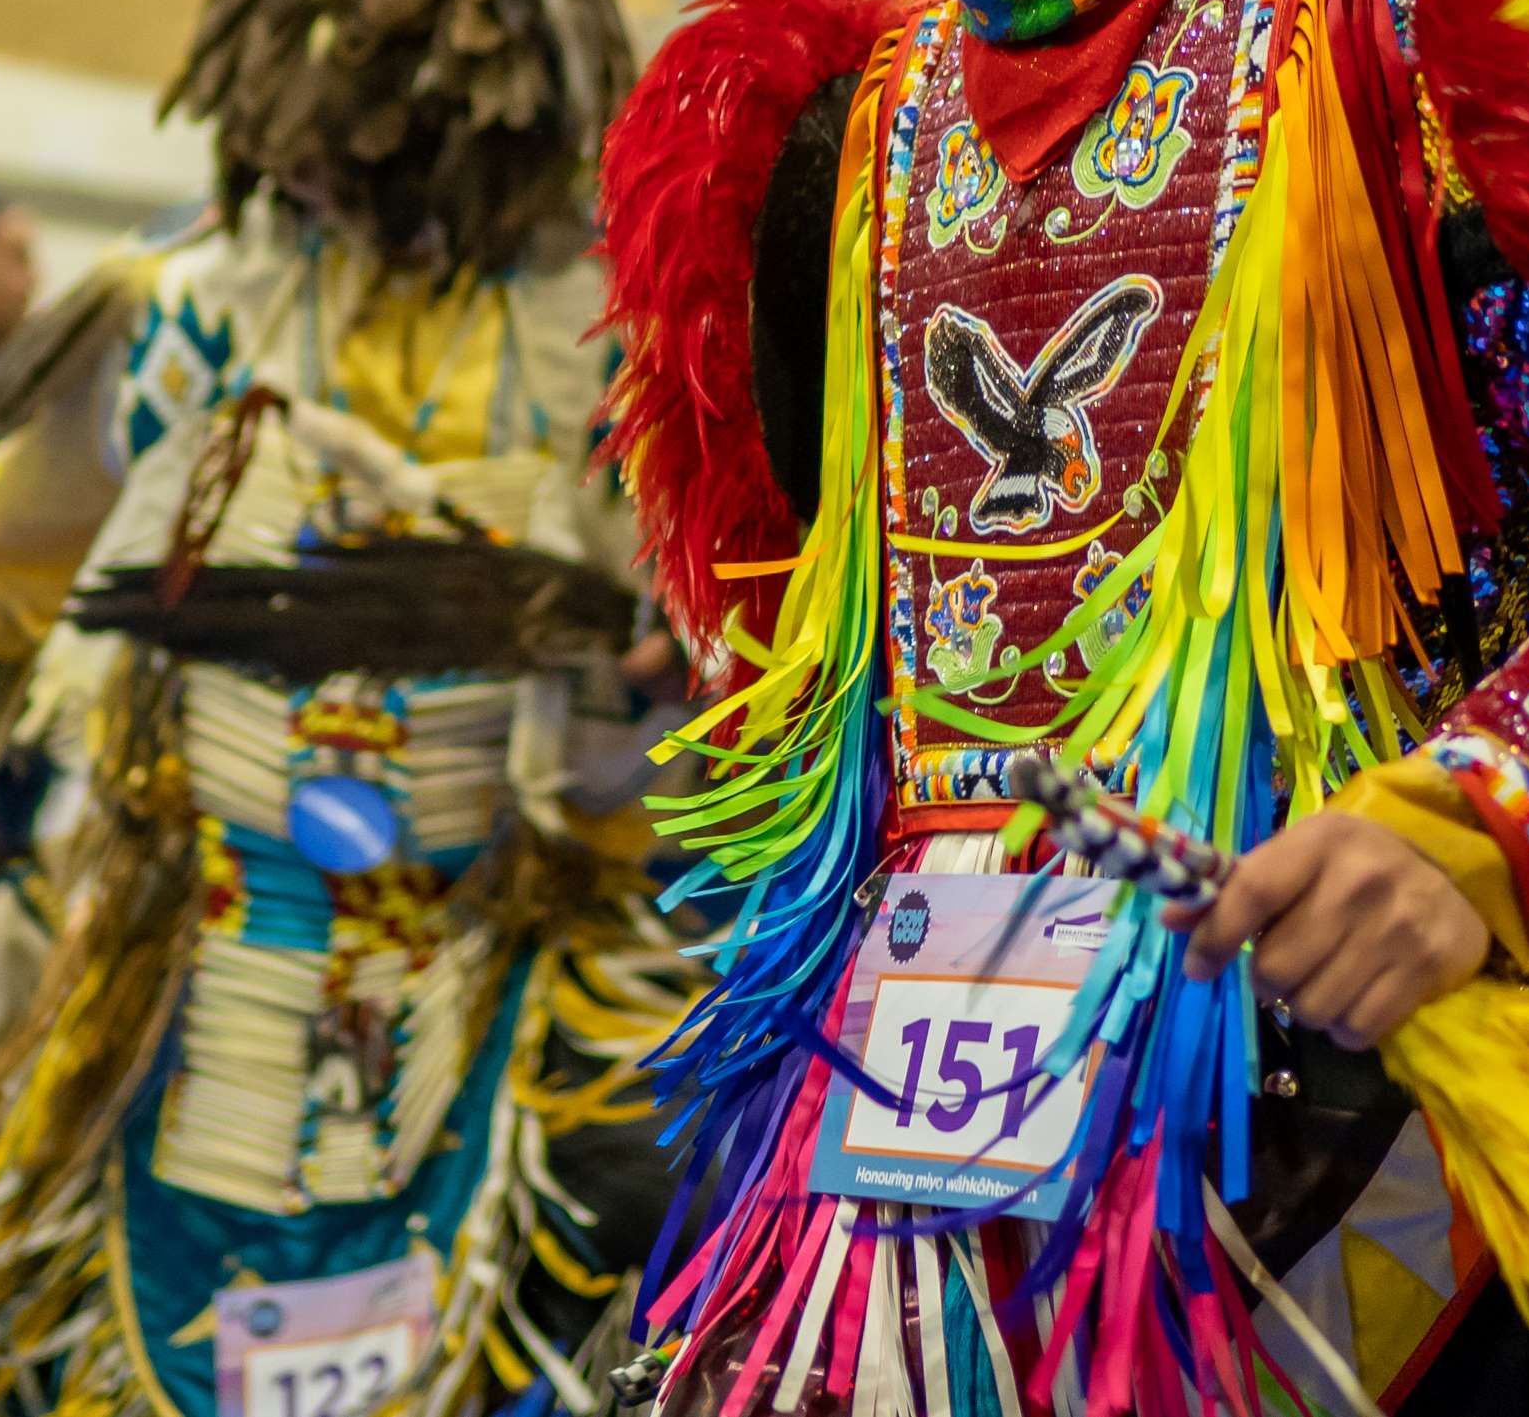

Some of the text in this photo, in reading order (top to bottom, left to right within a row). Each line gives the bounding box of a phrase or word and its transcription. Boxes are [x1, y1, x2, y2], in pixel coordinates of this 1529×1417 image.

[894, 909, 928, 929] POW
[892, 927, 924, 944] WOW
[896, 1018, 1040, 1138] 151
[855, 1165, 913, 1190] Honouring
[915, 1172, 943, 1193] miyo
